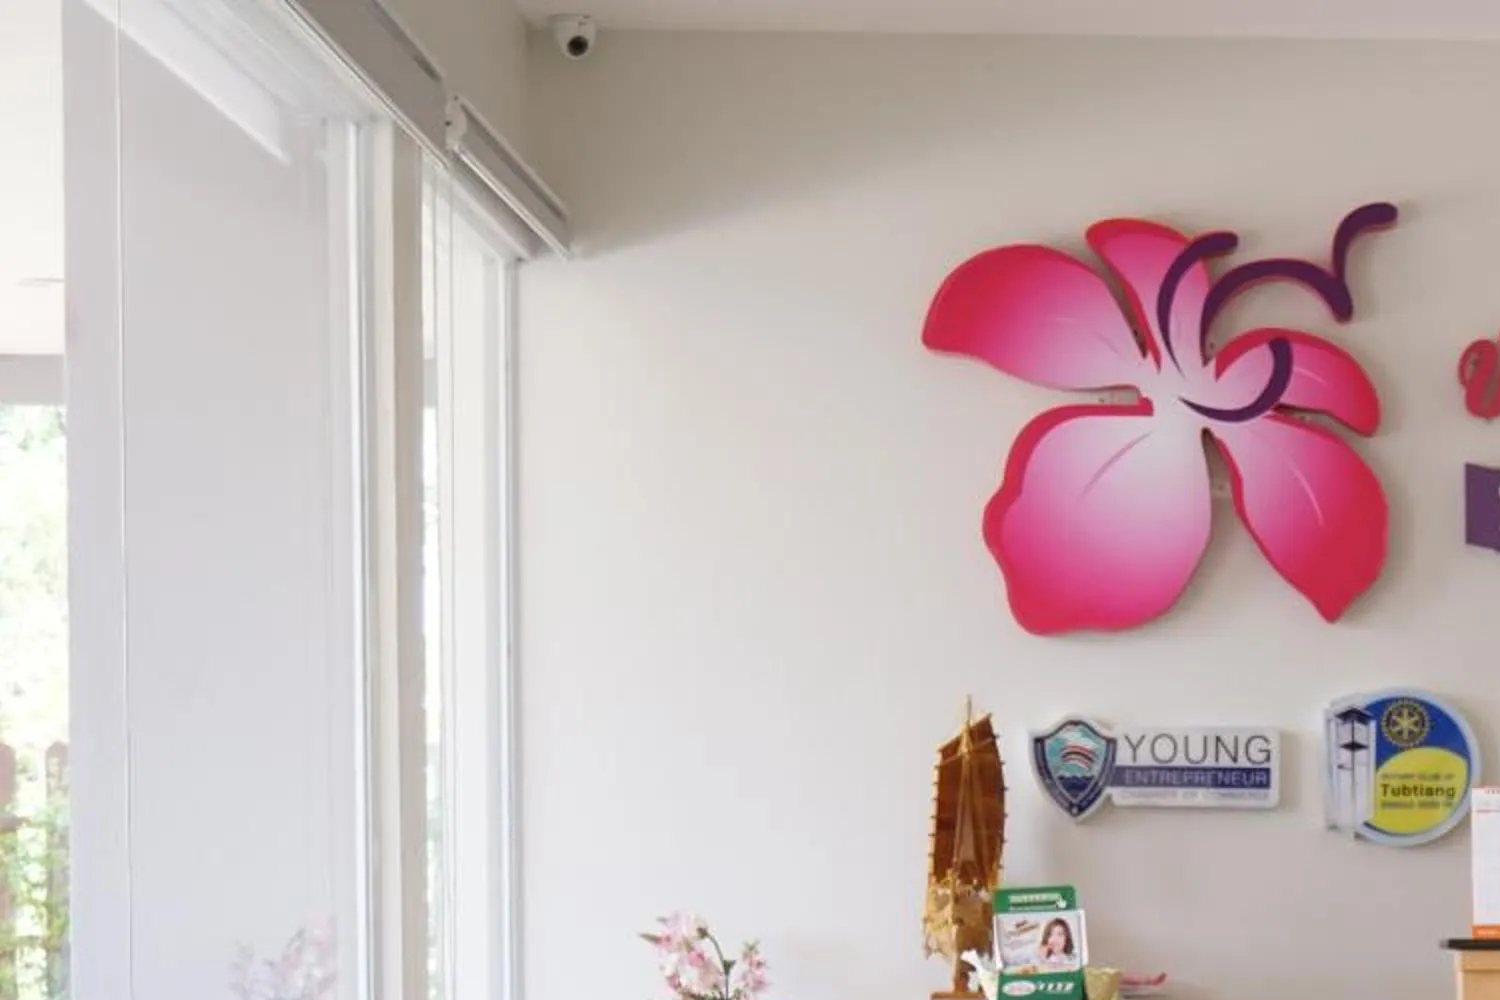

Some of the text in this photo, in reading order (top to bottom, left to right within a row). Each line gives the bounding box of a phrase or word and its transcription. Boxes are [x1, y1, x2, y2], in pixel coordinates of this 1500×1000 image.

[1123, 733, 1272, 765] YOUNG
[1124, 768, 1268, 786] ENTREPRENEUR
[1380, 783, 1456, 801] Tubtiang
